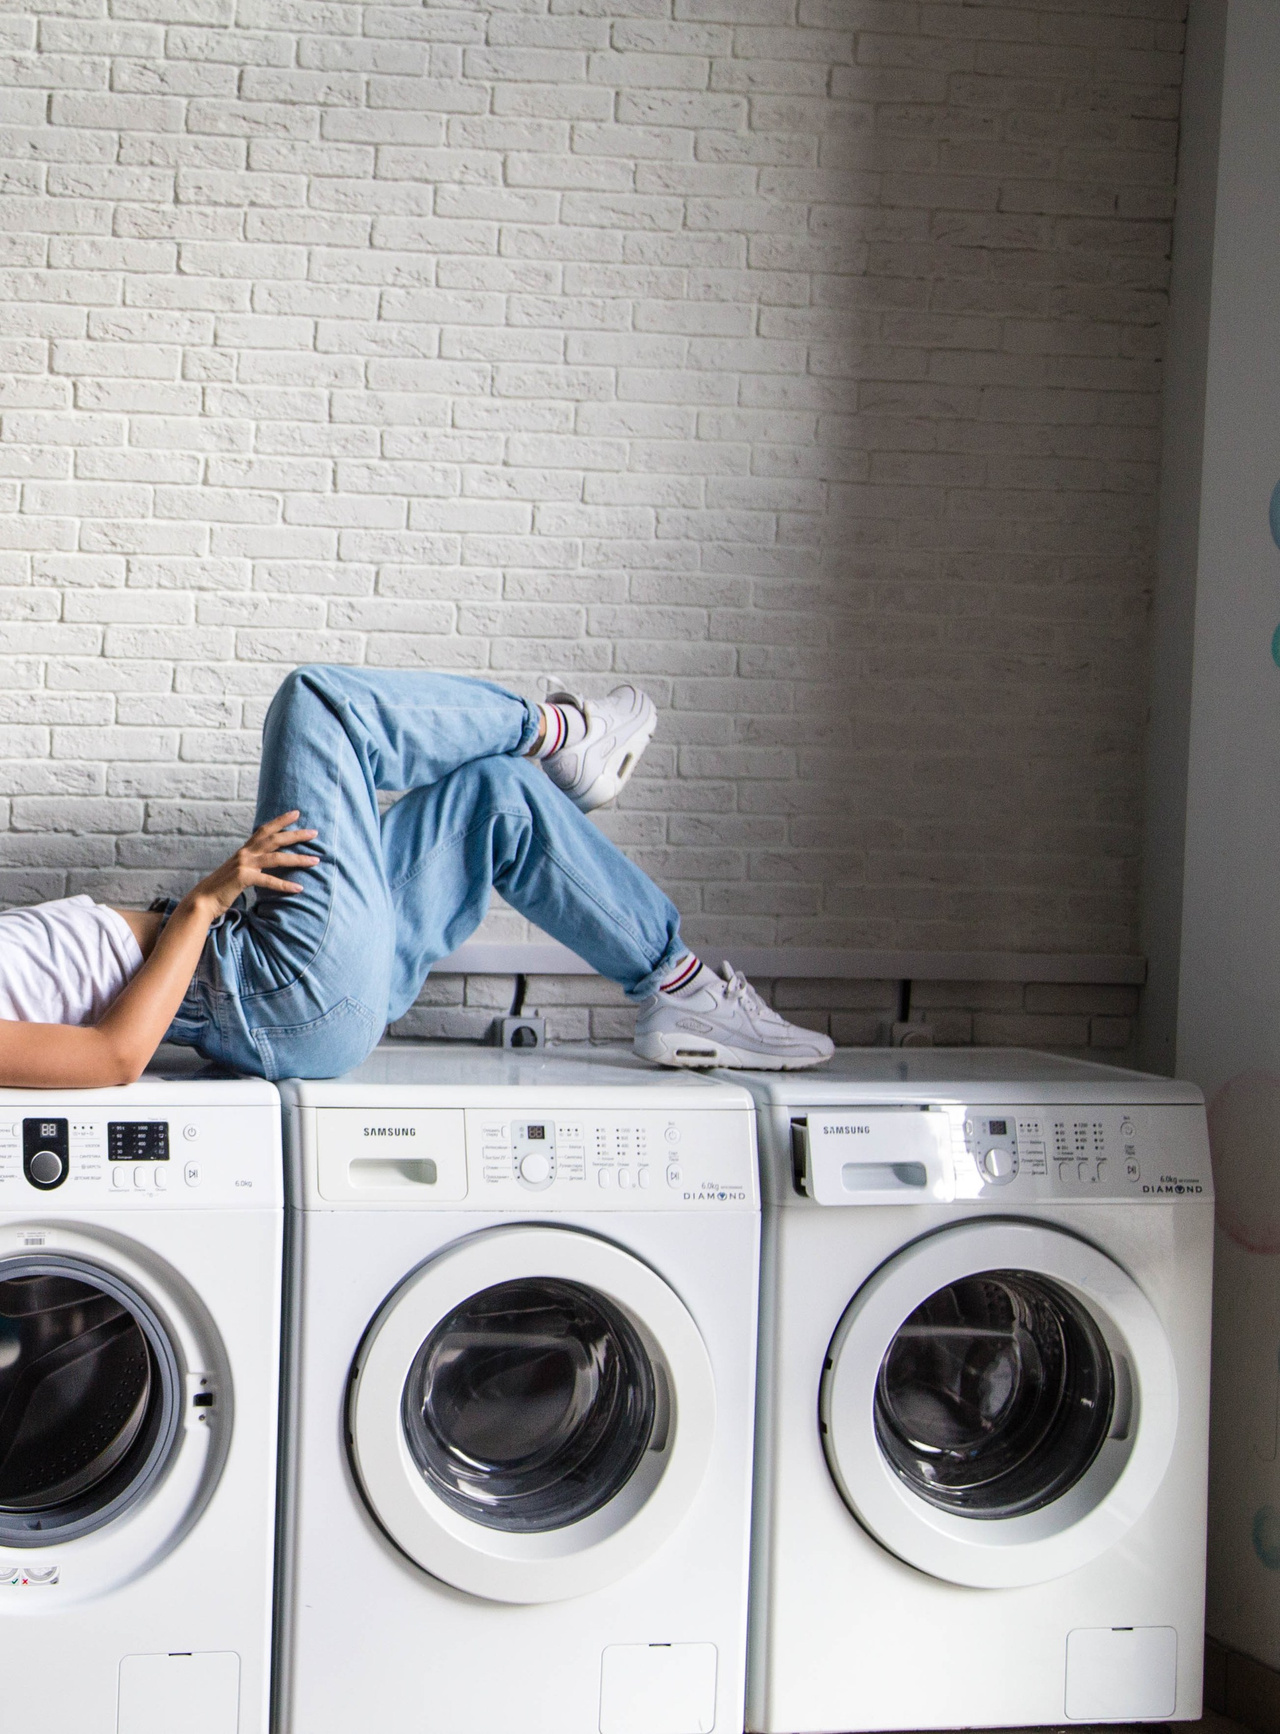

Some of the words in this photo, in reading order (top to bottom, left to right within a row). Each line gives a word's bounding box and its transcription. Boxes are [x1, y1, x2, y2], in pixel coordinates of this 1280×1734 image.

[363, 1127, 416, 1137] SAMSUNG
[823, 1126, 870, 1135] SAMSUNG
[1142, 1185, 1203, 1194] DIAMOND
[683, 1192, 746, 1201] DIAMOND
